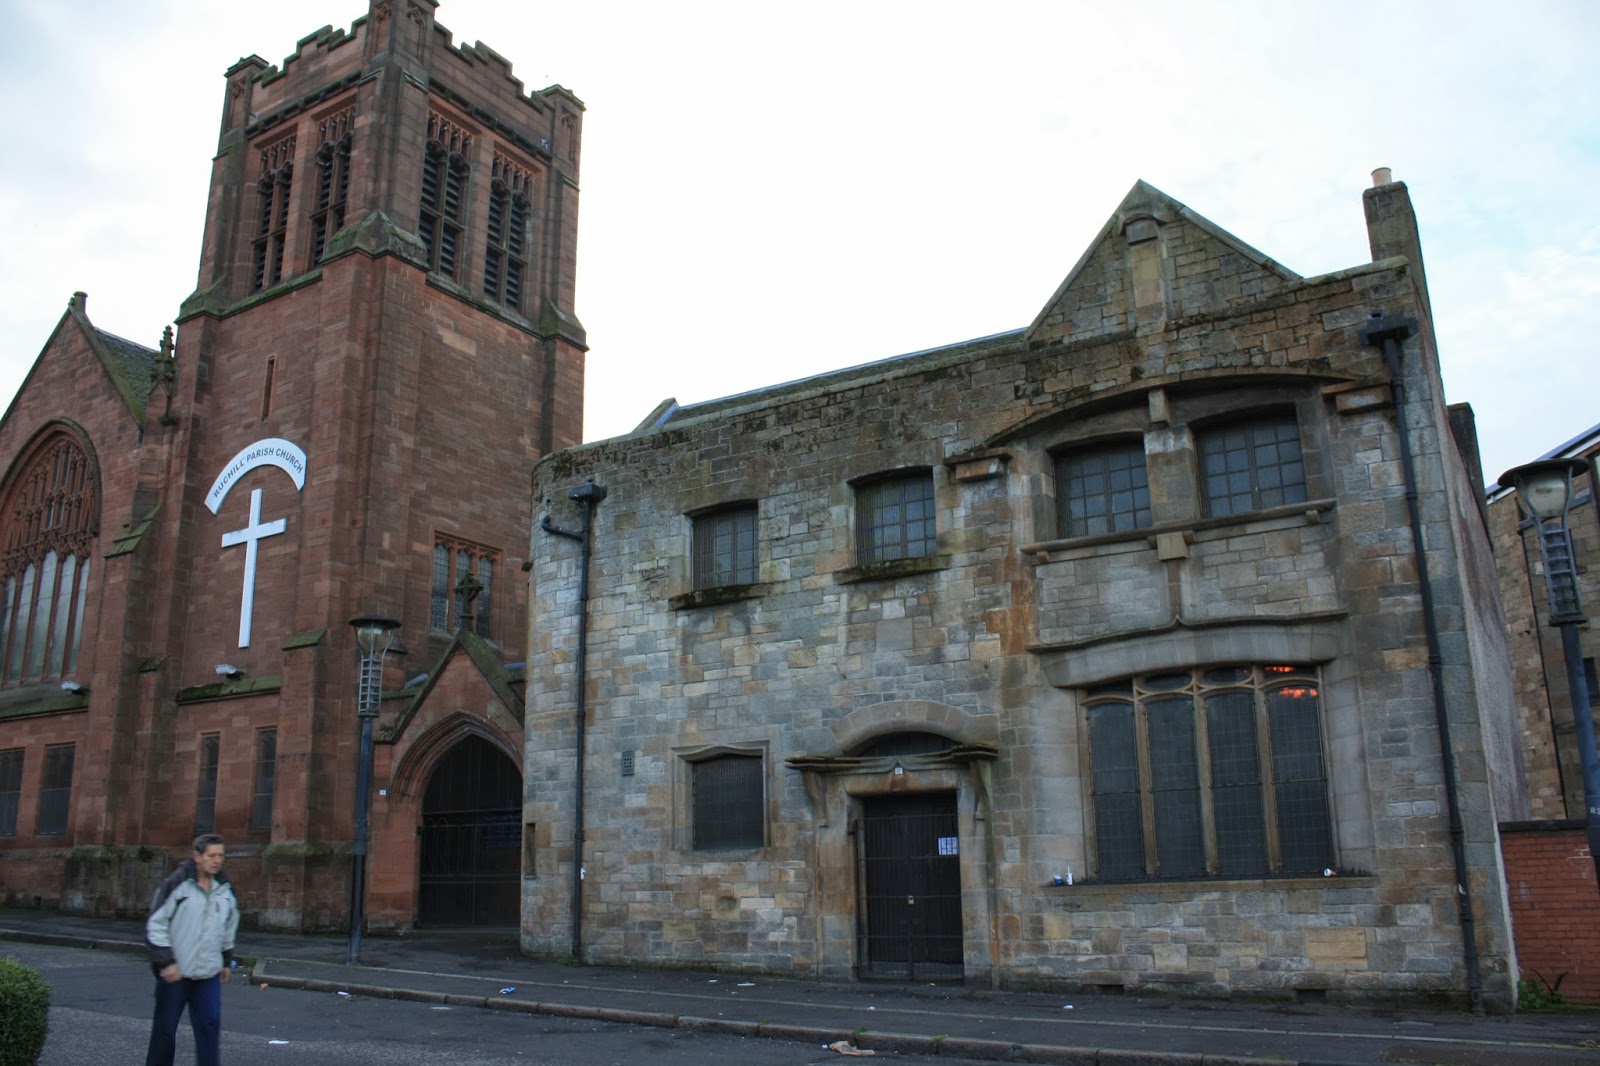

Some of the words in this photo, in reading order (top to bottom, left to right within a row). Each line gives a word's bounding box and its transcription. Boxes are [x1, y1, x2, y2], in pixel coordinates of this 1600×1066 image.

[213, 460, 245, 498] RUCHILL
[246, 447, 274, 463] PARISH
[276, 447, 303, 474] CHURCH
